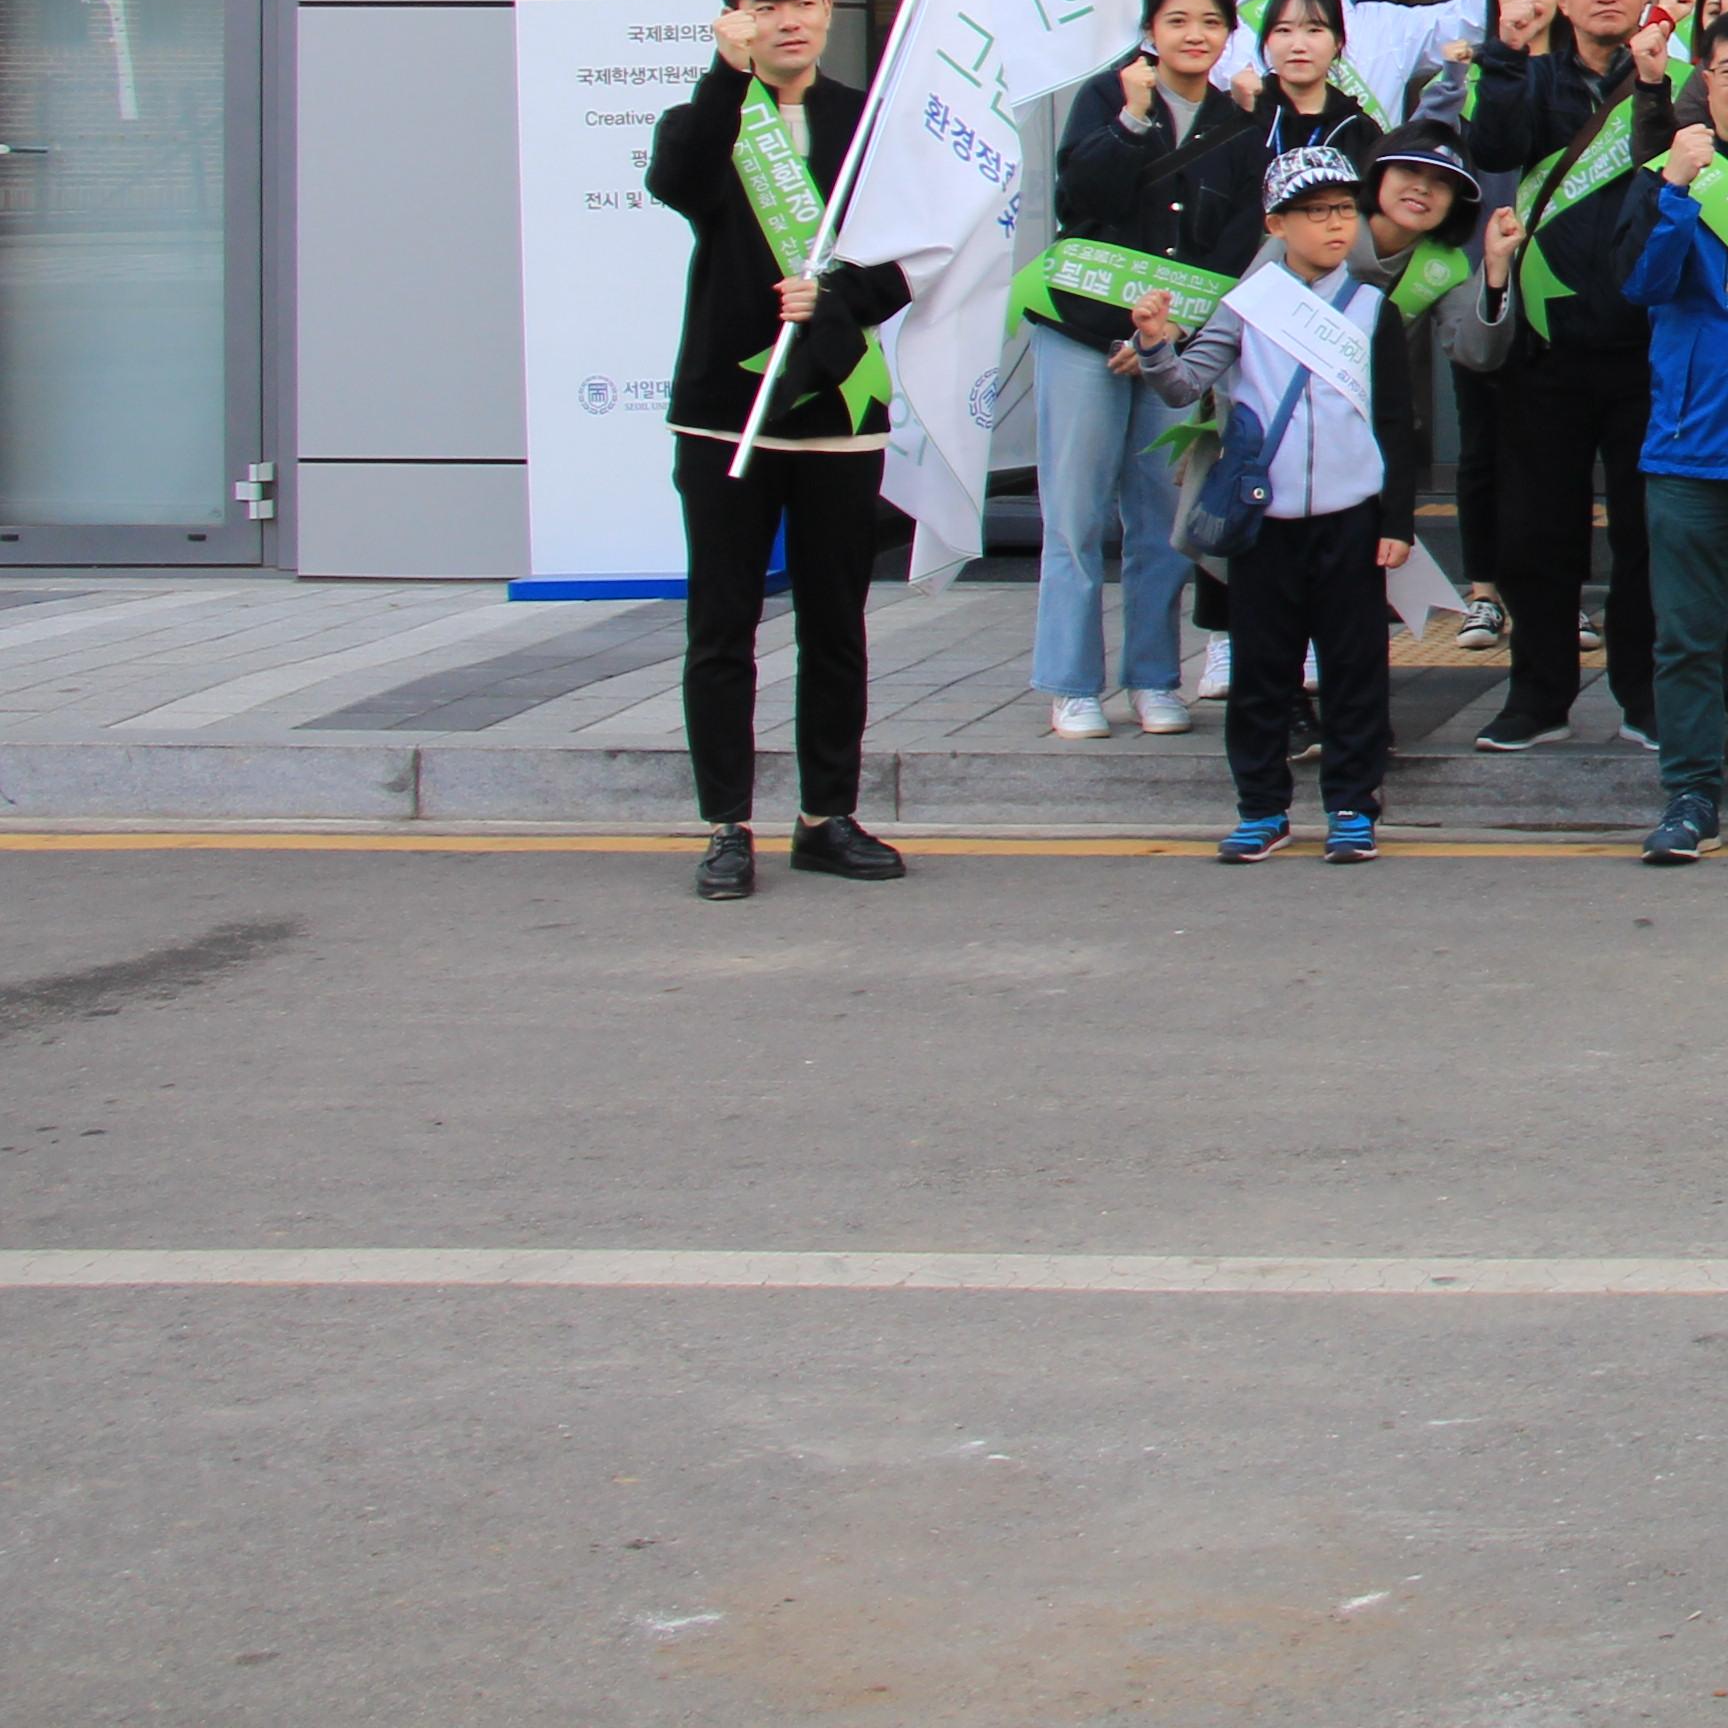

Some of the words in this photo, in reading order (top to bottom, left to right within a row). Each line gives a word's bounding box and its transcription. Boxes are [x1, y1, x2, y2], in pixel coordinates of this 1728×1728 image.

[585, 110, 656, 127] Creative
[740, 102, 820, 223] 그린환경
[585, 191, 619, 211] 전시
[626, 190, 643, 209] 및
